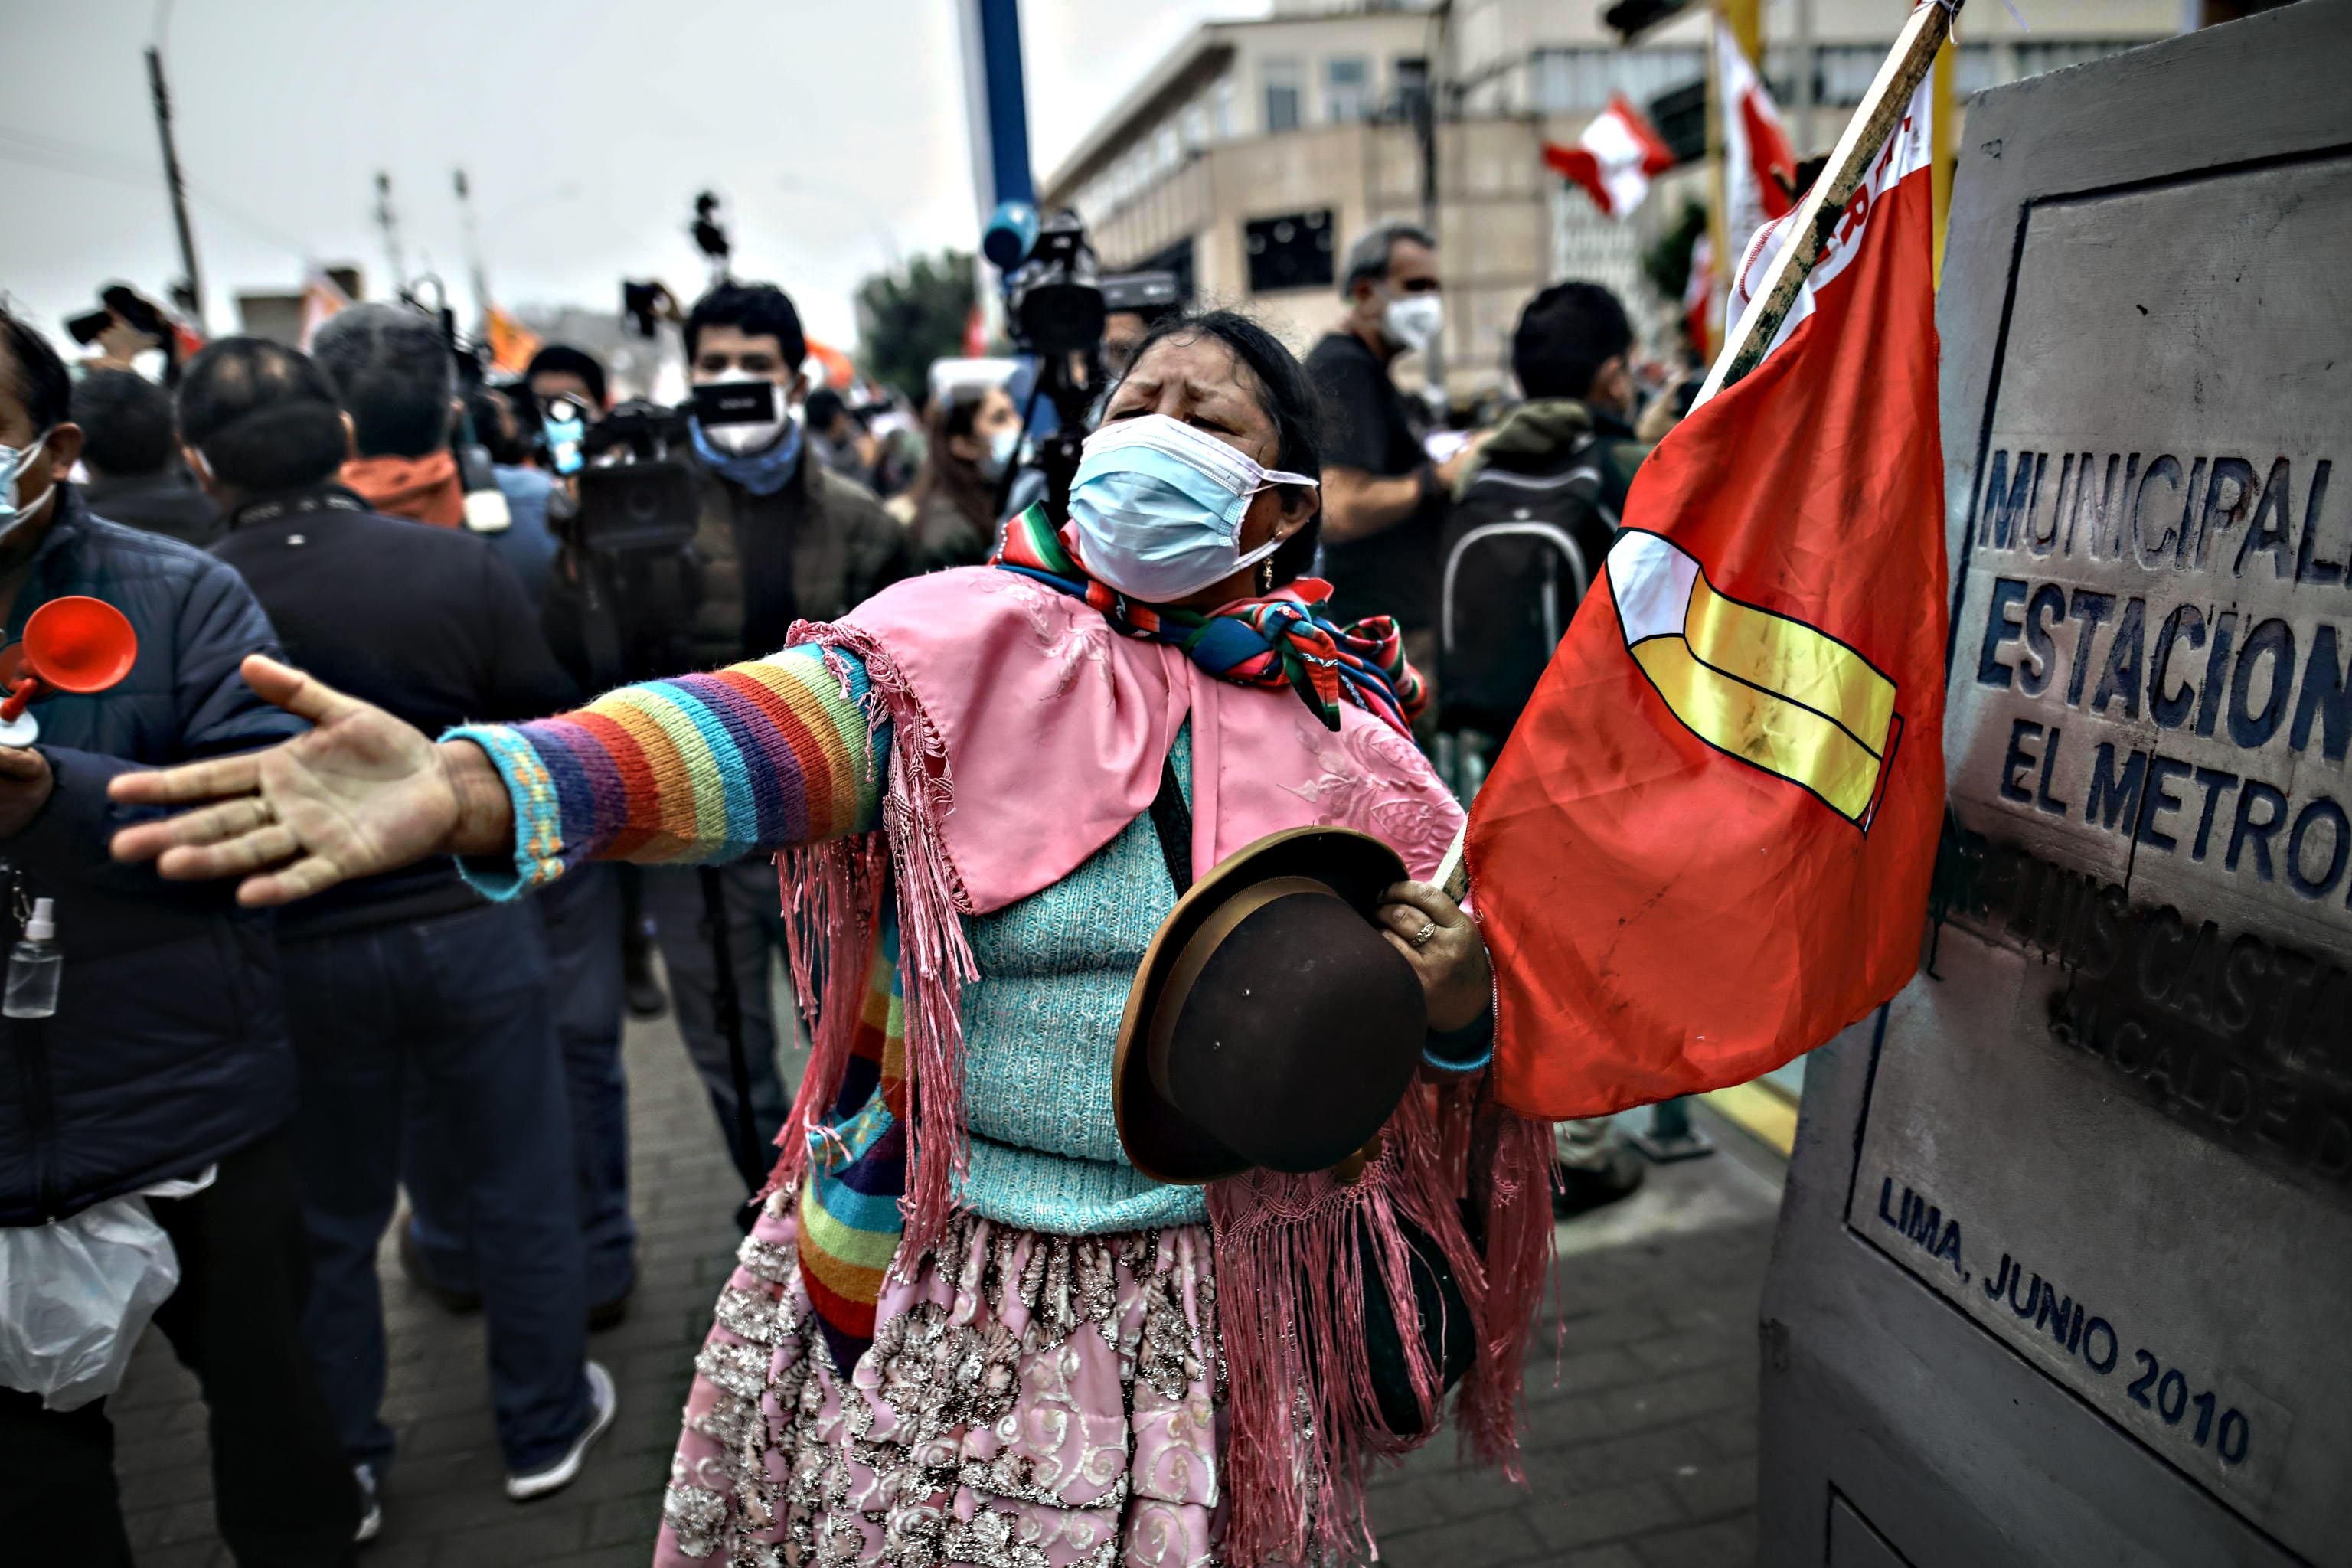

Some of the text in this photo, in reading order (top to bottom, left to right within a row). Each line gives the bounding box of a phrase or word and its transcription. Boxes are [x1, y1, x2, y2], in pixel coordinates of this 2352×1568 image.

[1978, 450, 2351, 590] MUNICIPAL
[2001, 718, 2066, 815] EL
[2084, 741, 2351, 910] METRO
[1878, 1177, 2249, 1465] LIMA, JUNIO 2010
